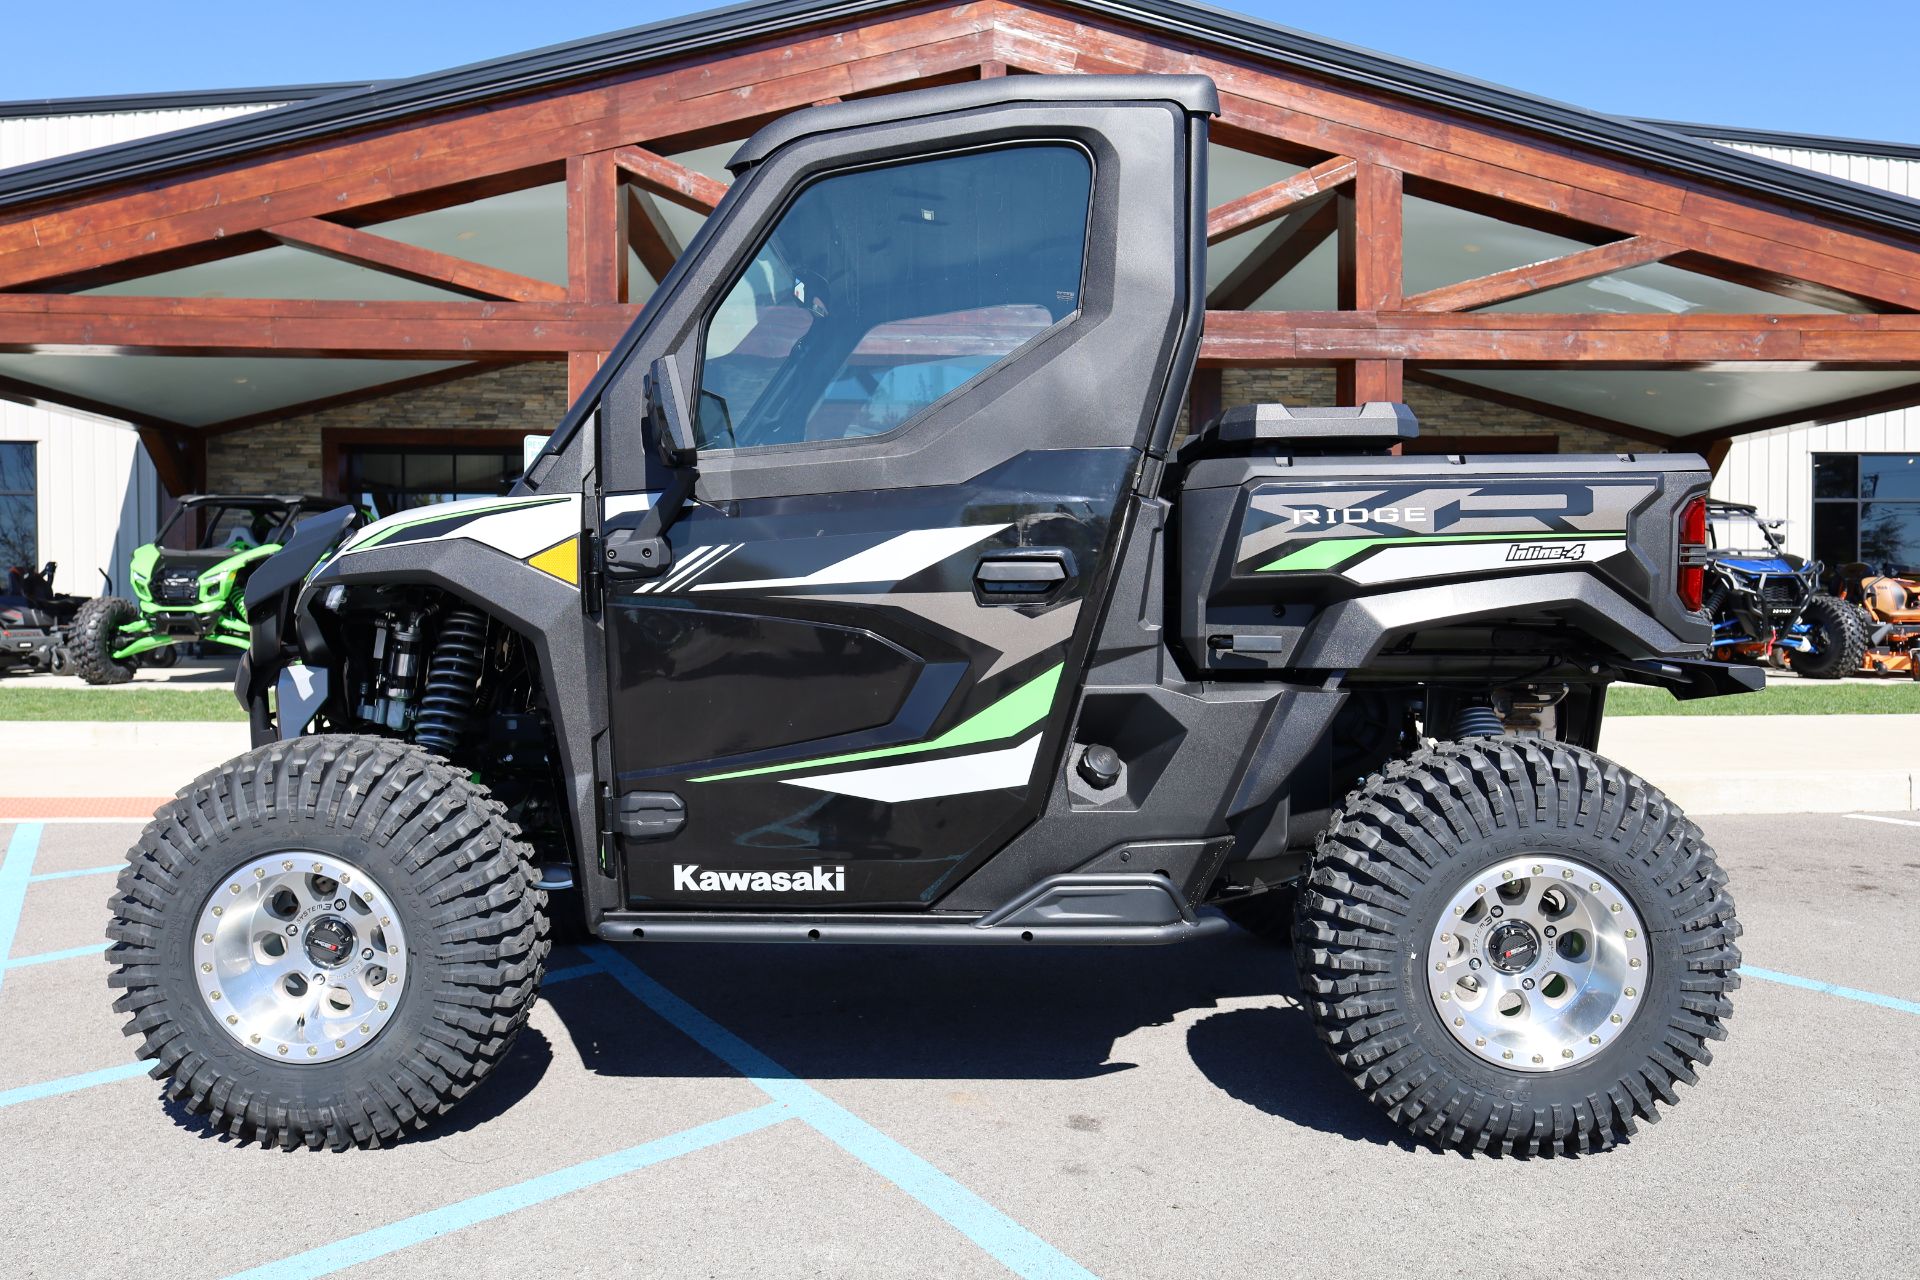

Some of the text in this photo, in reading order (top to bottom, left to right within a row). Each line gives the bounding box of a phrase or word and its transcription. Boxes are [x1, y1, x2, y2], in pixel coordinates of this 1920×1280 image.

[1293, 507, 1427, 525] RIDGE
[1505, 544, 1586, 561] Inline-4
[673, 864, 845, 892] Kawasaki
